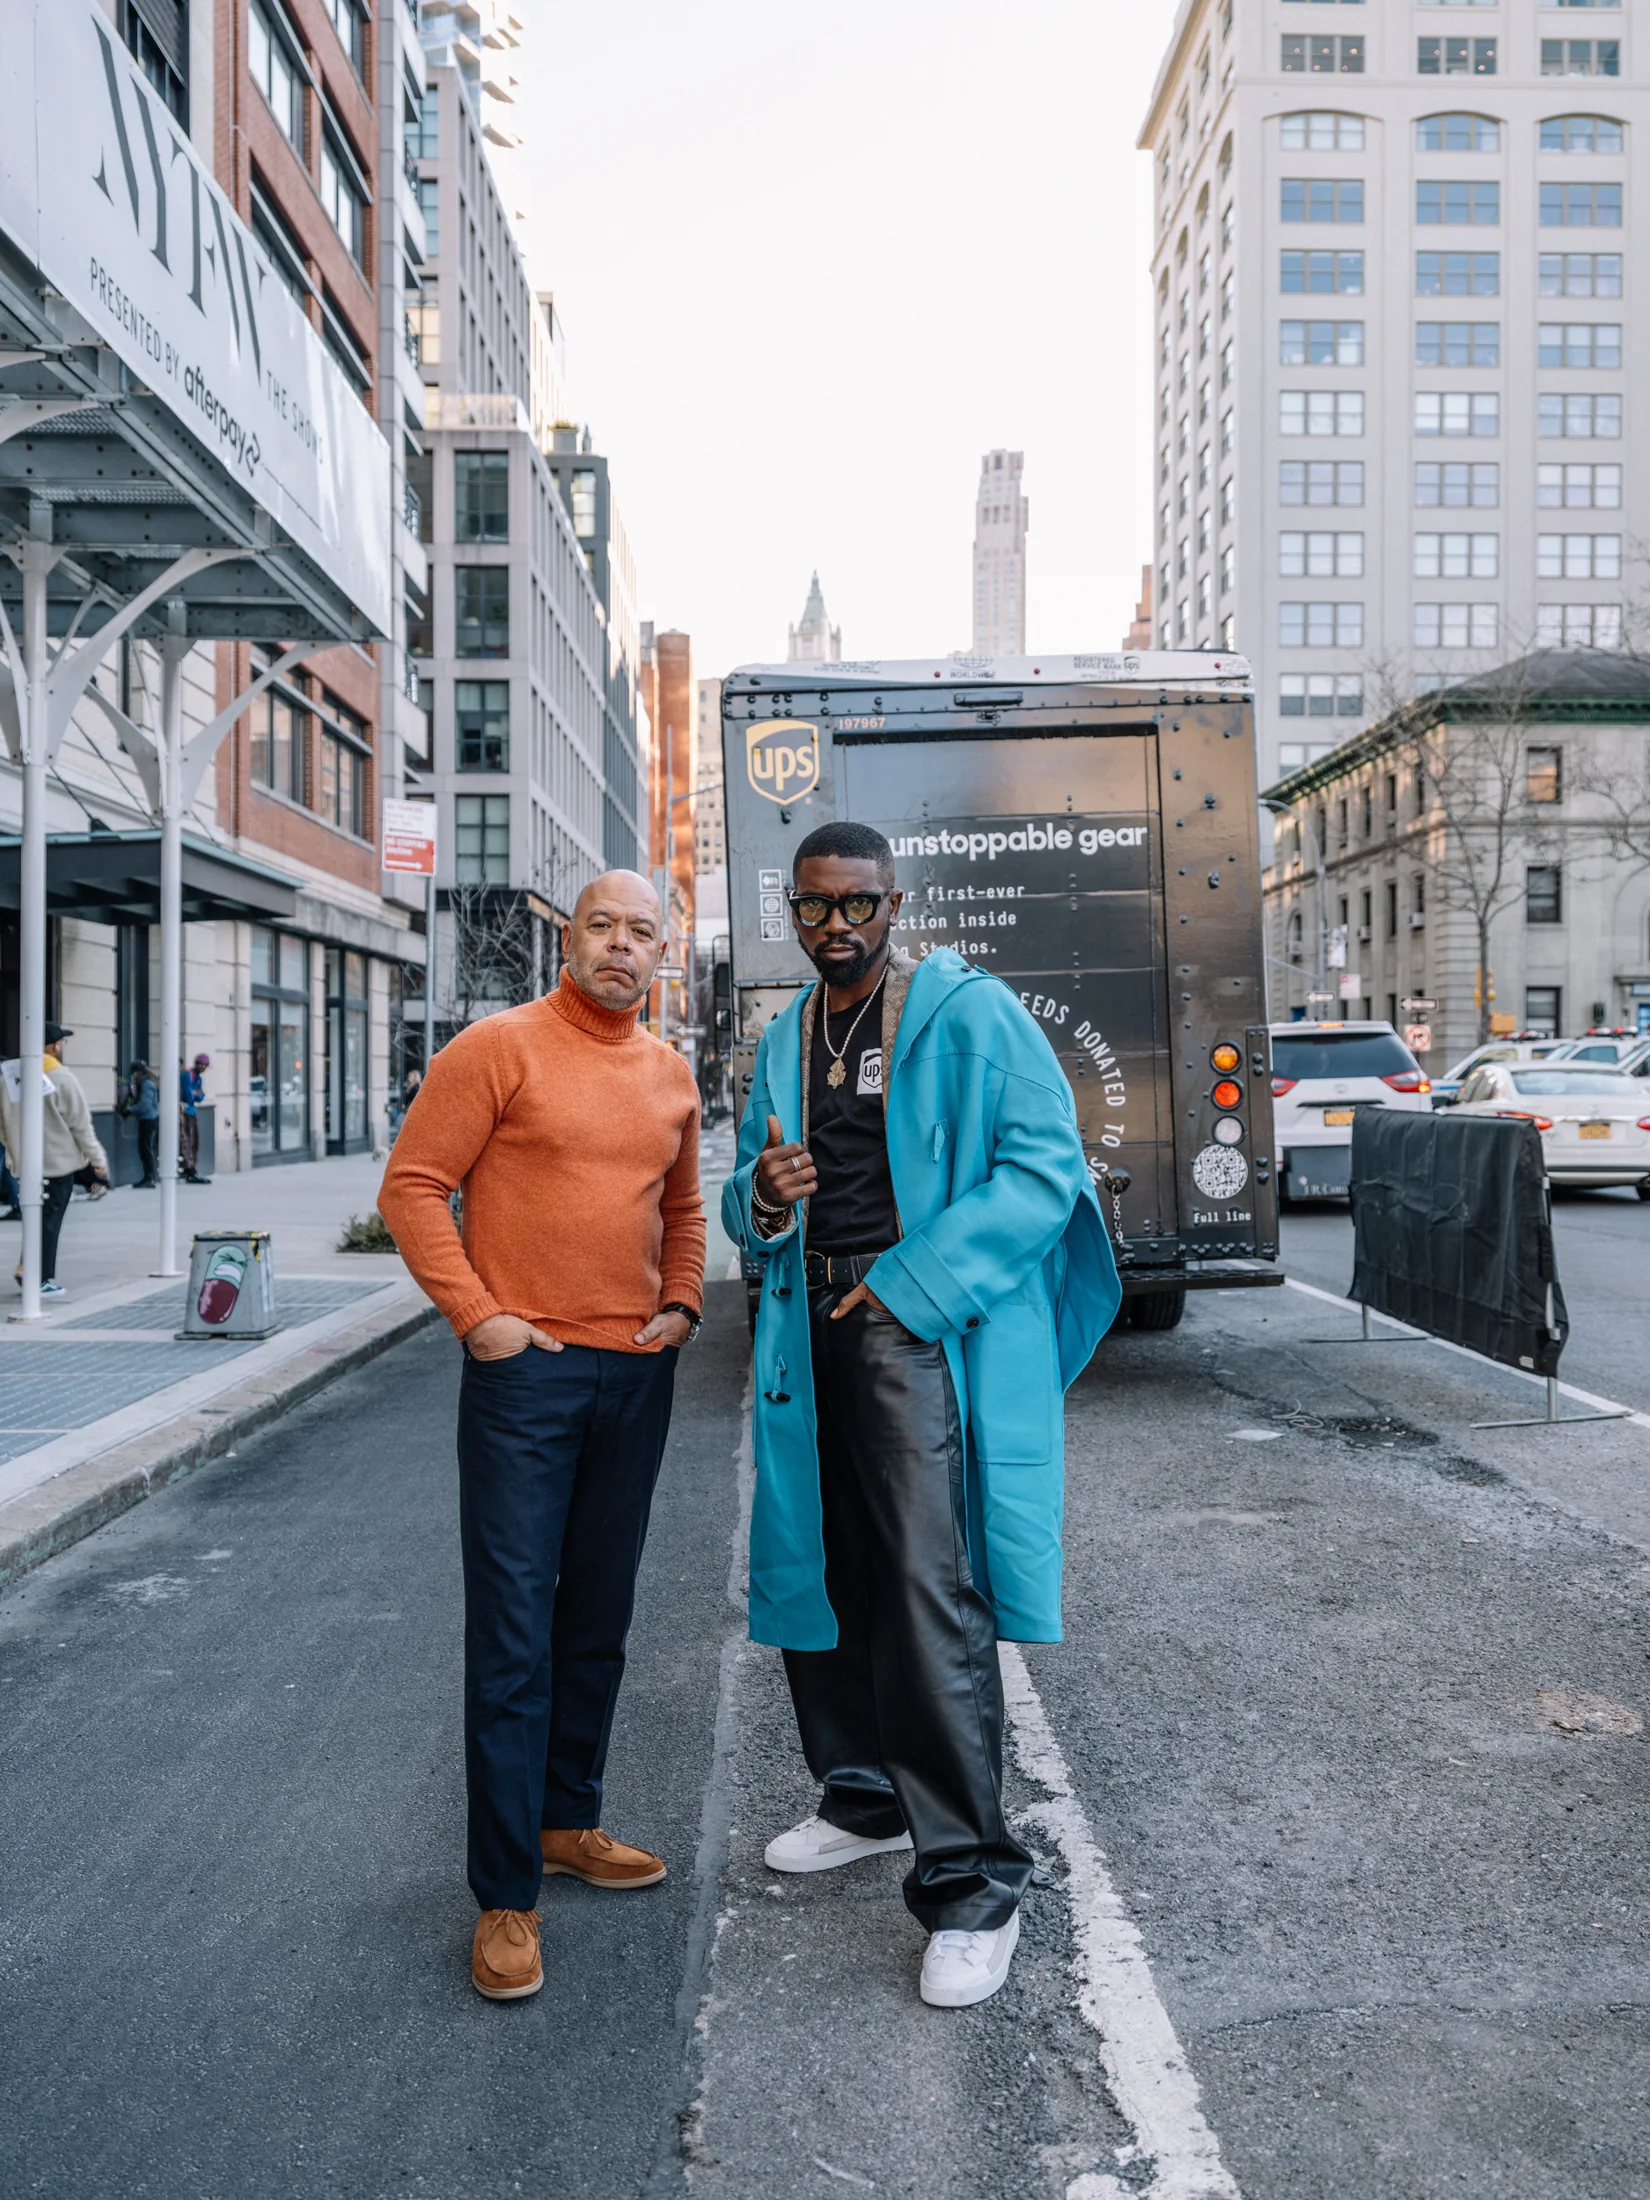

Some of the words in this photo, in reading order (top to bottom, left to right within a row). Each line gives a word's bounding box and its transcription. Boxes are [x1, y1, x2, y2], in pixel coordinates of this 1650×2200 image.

[91, 256, 161, 363] PRESENTED
[166, 342, 179, 382] BY
[185, 366, 246, 464] afterpay
[267, 370, 287, 421] THE
[292, 402, 324, 465] SHOWS
[839, 717, 886, 730] 197967
[753, 745, 815, 791] ups
[889, 822, 1073, 861] unstoppable
[1078, 826, 1148, 855] gear
[927, 885, 1025, 902] first-ever
[958, 910, 1017, 928] inside
[864, 1063, 882, 1083] up
[1073, 1020, 1126, 1107] DONATED
[1101, 1123, 1125, 1148] TO
[1193, 1211, 1219, 1224] Full
[1226, 1211, 1252, 1222] line
